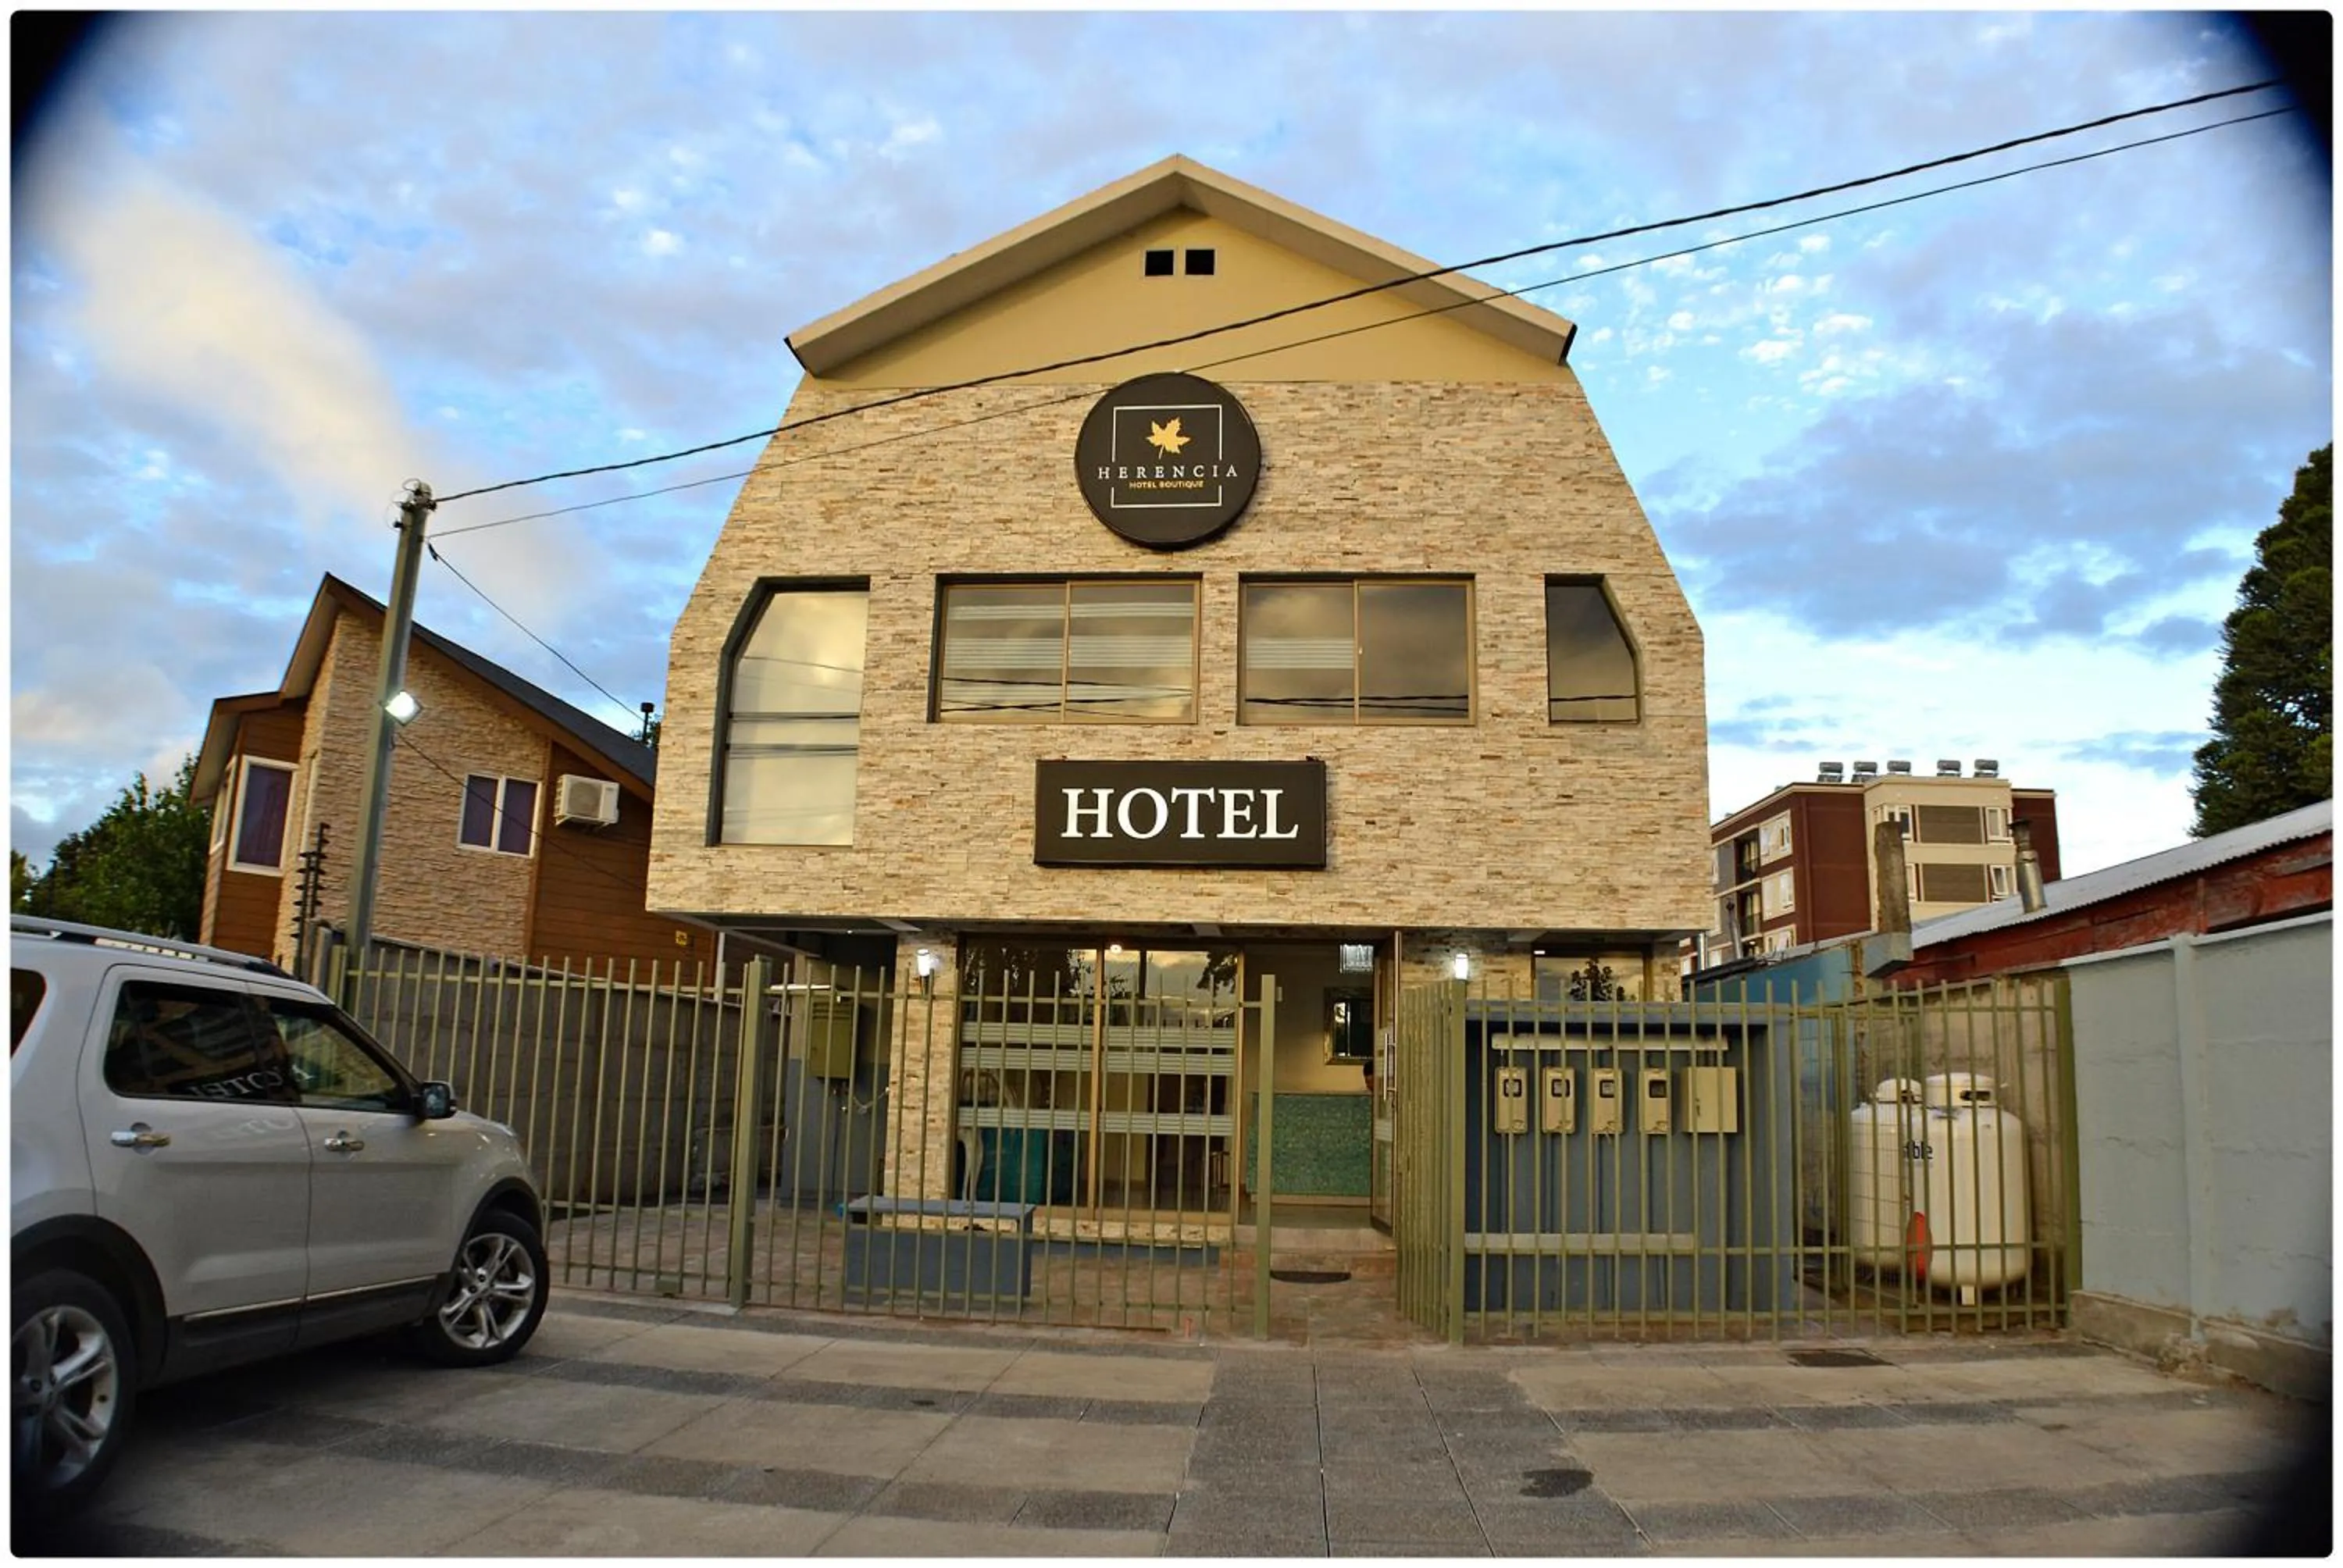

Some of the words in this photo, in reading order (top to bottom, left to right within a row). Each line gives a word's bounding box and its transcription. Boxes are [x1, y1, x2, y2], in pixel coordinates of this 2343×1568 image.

[1097, 464, 1238, 479] HERENCIA
[1159, 479, 1204, 490] BOUTIQUE
[1061, 787, 1299, 840] HOTEL
